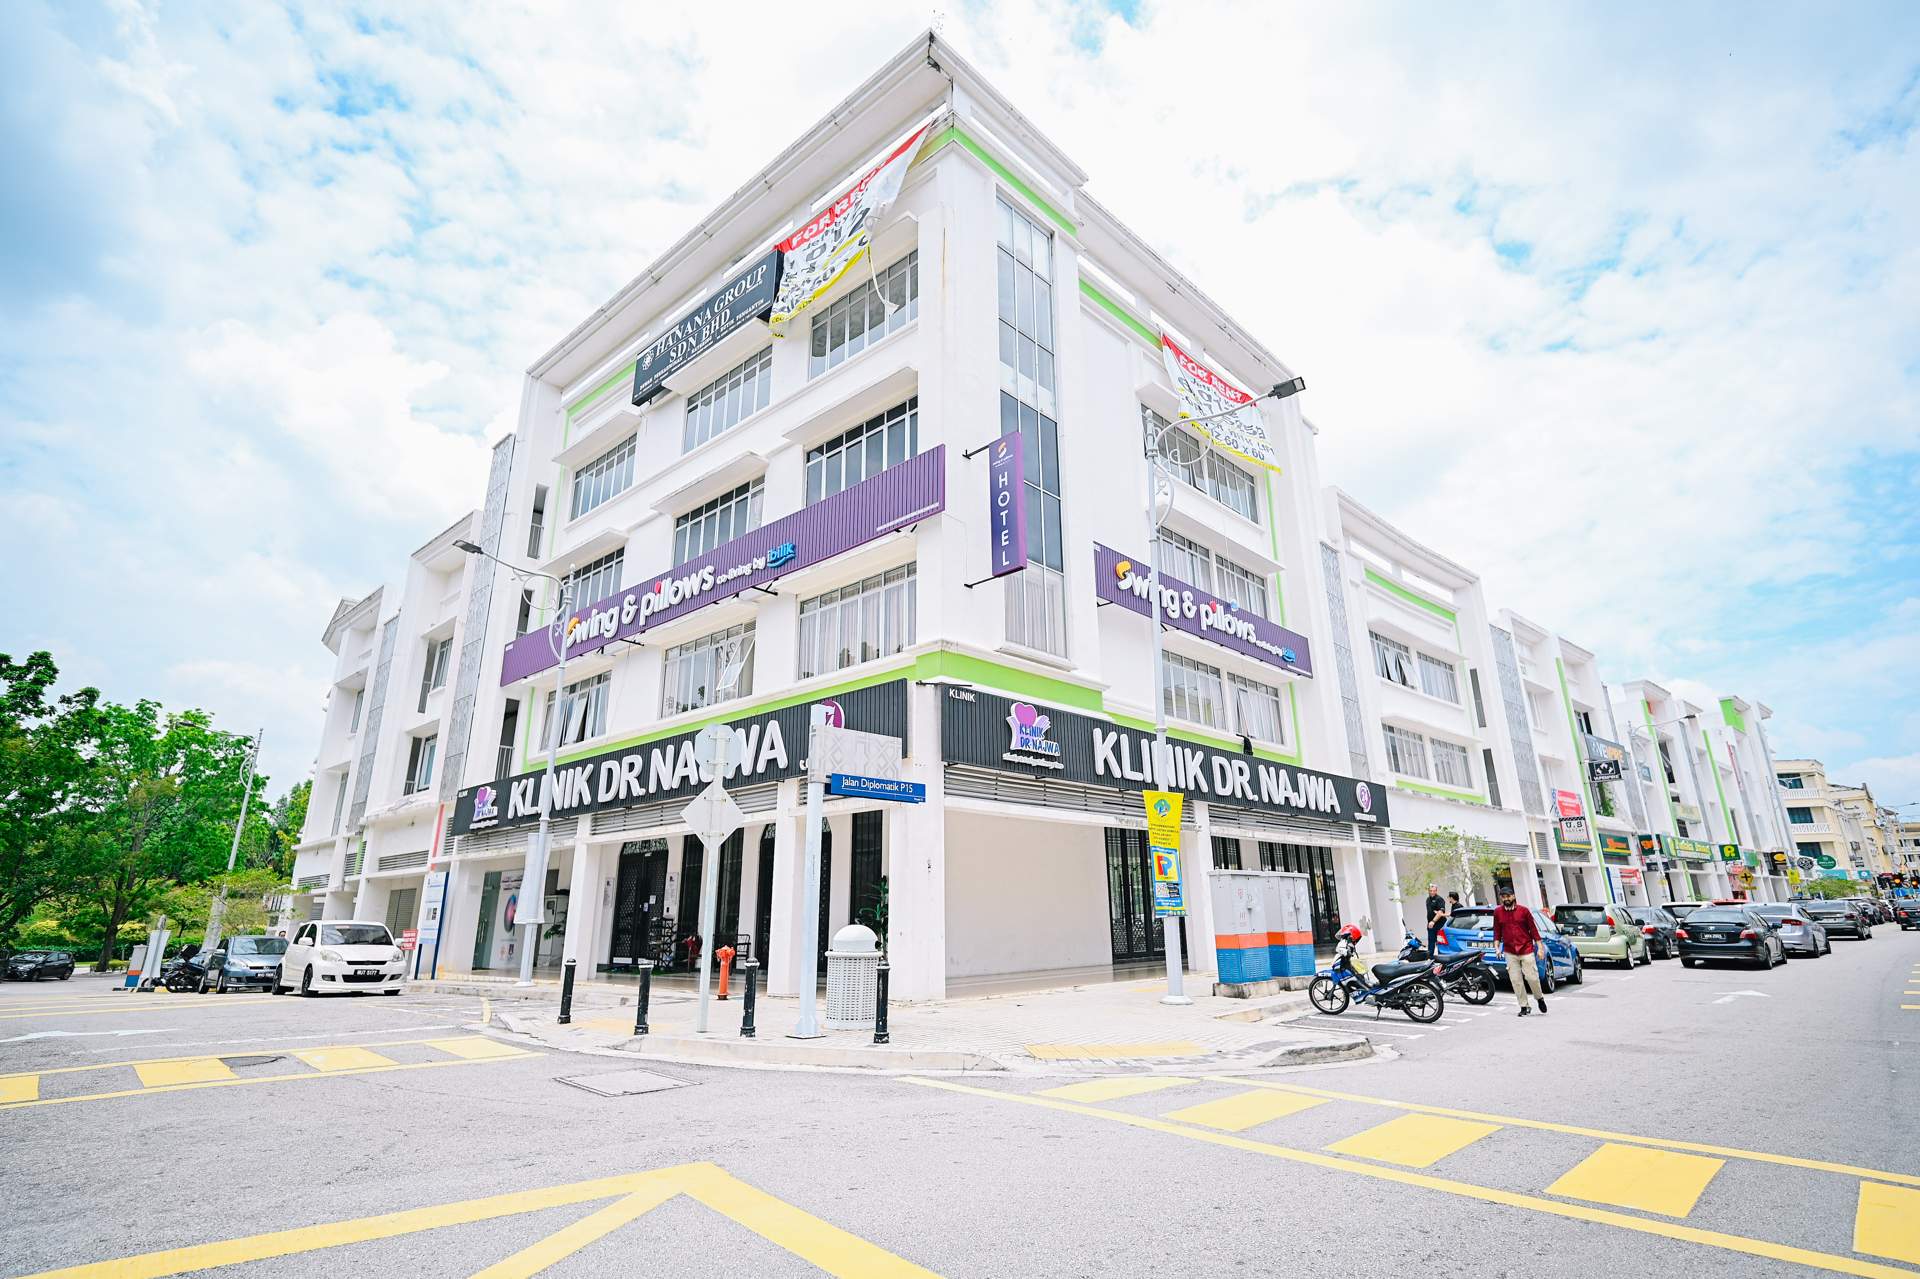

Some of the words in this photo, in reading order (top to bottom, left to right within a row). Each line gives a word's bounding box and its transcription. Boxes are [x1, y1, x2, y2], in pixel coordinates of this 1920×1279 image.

[791, 212, 831, 247] FOR
[655, 306, 712, 356] HANANA
[714, 264, 767, 312] GROUP
[669, 335, 698, 363] SDN
[703, 308, 731, 340] BHD
[997, 471, 1010, 566] HOTEL
[567, 605, 620, 648] Swing
[621, 594, 639, 625] &
[638, 565, 716, 626] pillows
[1115, 560, 1180, 619] Swng
[1182, 591, 1198, 619] &
[1200, 600, 1257, 644] pillows
[950, 688, 976, 703] KLINIK
[649, 720, 789, 794] NAWA
[1020, 723, 1044, 738] KLINIK
[842, 776, 859, 788] Jalan
[860, 778, 899, 792] Diplomatik
[900, 783, 913, 793] P15
[1258, 764, 1341, 814] NAJWA
